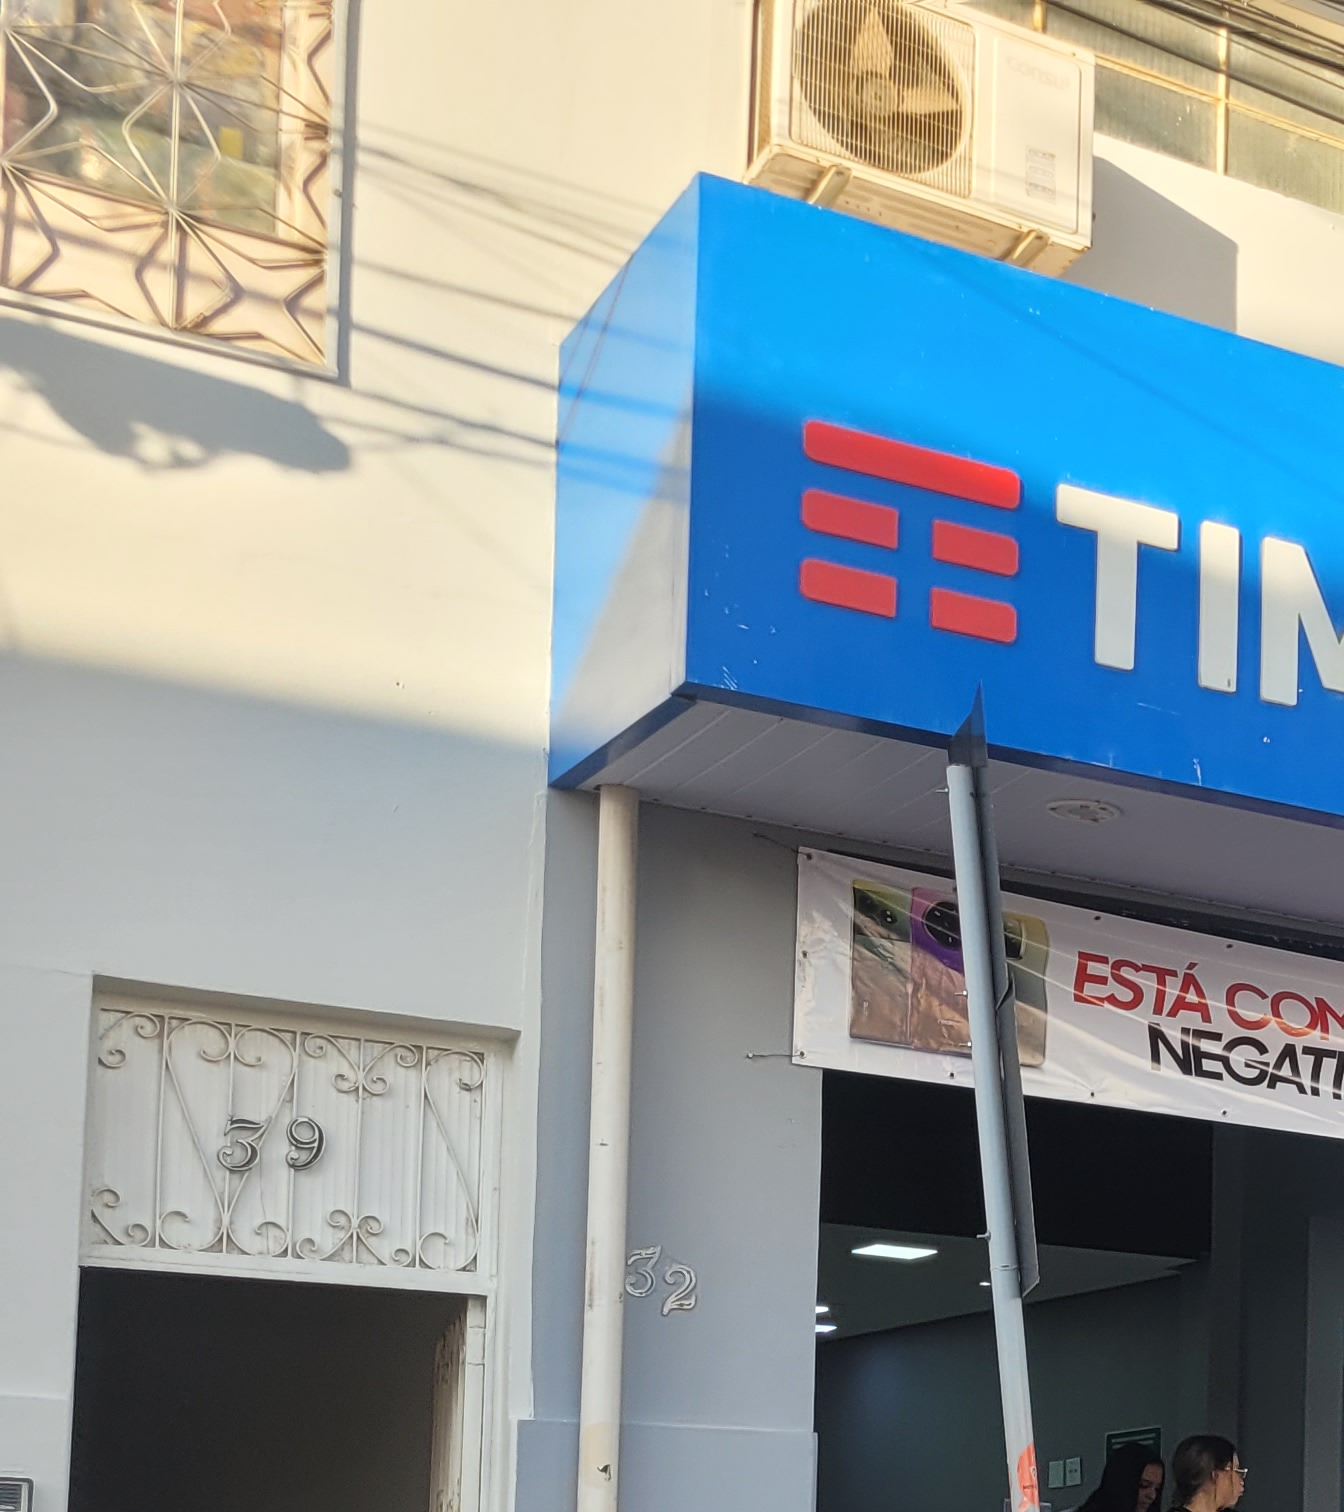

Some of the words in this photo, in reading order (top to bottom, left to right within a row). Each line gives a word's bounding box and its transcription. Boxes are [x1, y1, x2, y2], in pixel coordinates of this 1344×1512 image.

[1073, 951, 1212, 1024] ESTÁ
[217, 1116, 326, 1171] 39
[625, 1245, 697, 1316] 32
